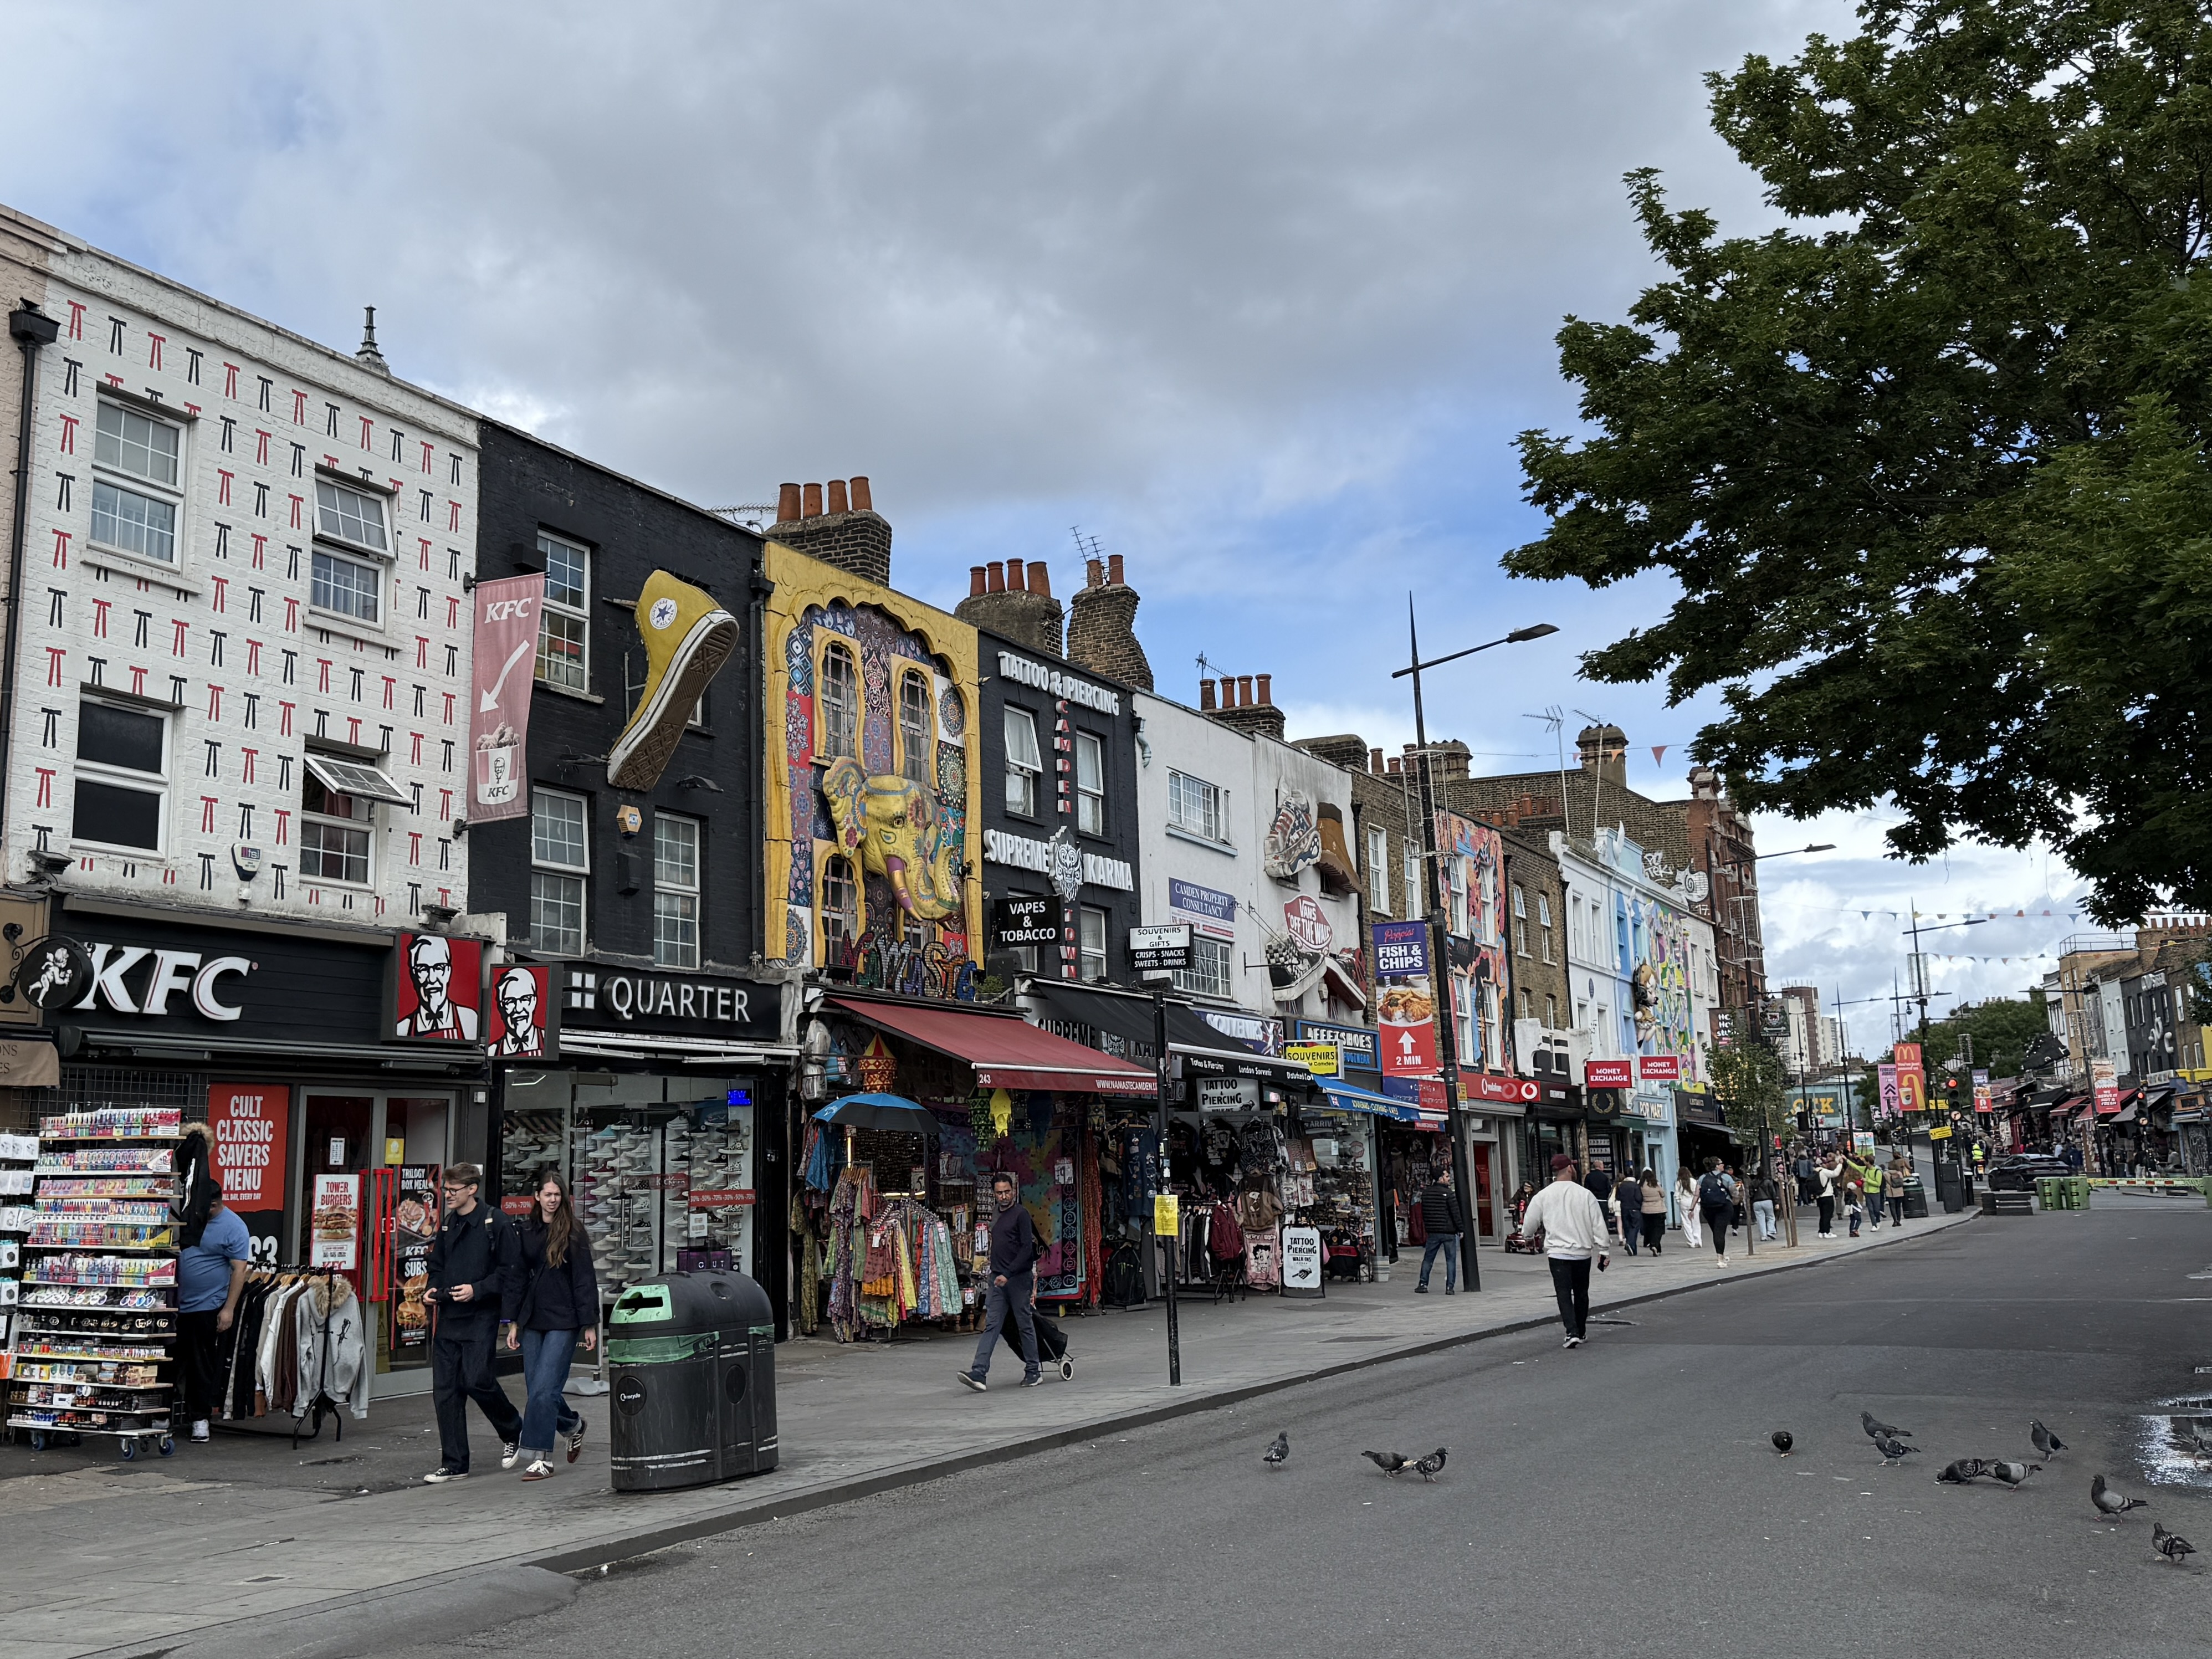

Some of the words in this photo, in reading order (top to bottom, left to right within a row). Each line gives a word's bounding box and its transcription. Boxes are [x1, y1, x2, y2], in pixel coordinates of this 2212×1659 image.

[484, 598, 532, 623] KFC
[998, 651, 1049, 692] TATTOO
[1049, 671, 1063, 697] &
[1063, 676, 1120, 716] PIERCING
[1054, 700, 1072, 813] CAMDEN
[488, 785, 509, 797] KFC
[984, 829, 1051, 873] SUPREME
[1083, 853, 1134, 892] KARMA
[1175, 883, 1200, 898] CAMDEN
[1200, 889, 1228, 907] PROPERTY
[1009, 902, 1046, 915] VAPES
[1182, 897, 1223, 917] CONSULTANCY
[1299, 899, 1317, 921] VANS
[1023, 915, 1033, 927] &
[1000, 928, 1056, 941] TOBACCO
[1138, 927, 1181, 935] SOUVENIRS
[1301, 918, 1315, 944] THE
[1161, 949, 1185, 957] SNACKS
[1378, 945, 1408, 957] FISH
[1411, 945, 1422, 956] &
[1380, 956, 1423, 970] CHIPS
[72, 943, 251, 1021] KFC
[608, 976, 751, 1022] QUARTER
[1288, 1051, 1335, 1061] SOUVENIRS
[1396, 1057, 1402, 1066] 2
[1404, 1056, 1421, 1065] MIN
[979, 1074, 991, 1084] 243
[1204, 1079, 1238, 1091] TATTOO
[1202, 1092, 1242, 1105] PIERCING
[230, 1095, 263, 1118] CULT
[1639, 1101, 1650, 1117] POP
[1650, 1103, 1663, 1118] MART
[217, 1119, 274, 1142] CLASSIC
[217, 1144, 270, 1166] SAVERS
[223, 1169, 262, 1191] MENU
[402, 1168, 426, 1179] TRILOGY
[326, 1181, 349, 1193] TOWER
[401, 1179, 413, 1190] BOX
[414, 1179, 429, 1190] MEAL
[321, 1194, 352, 1206] BURGERS
[1287, 1245, 1317, 1254] PIERCING
[404, 1261, 428, 1277] SUBS
